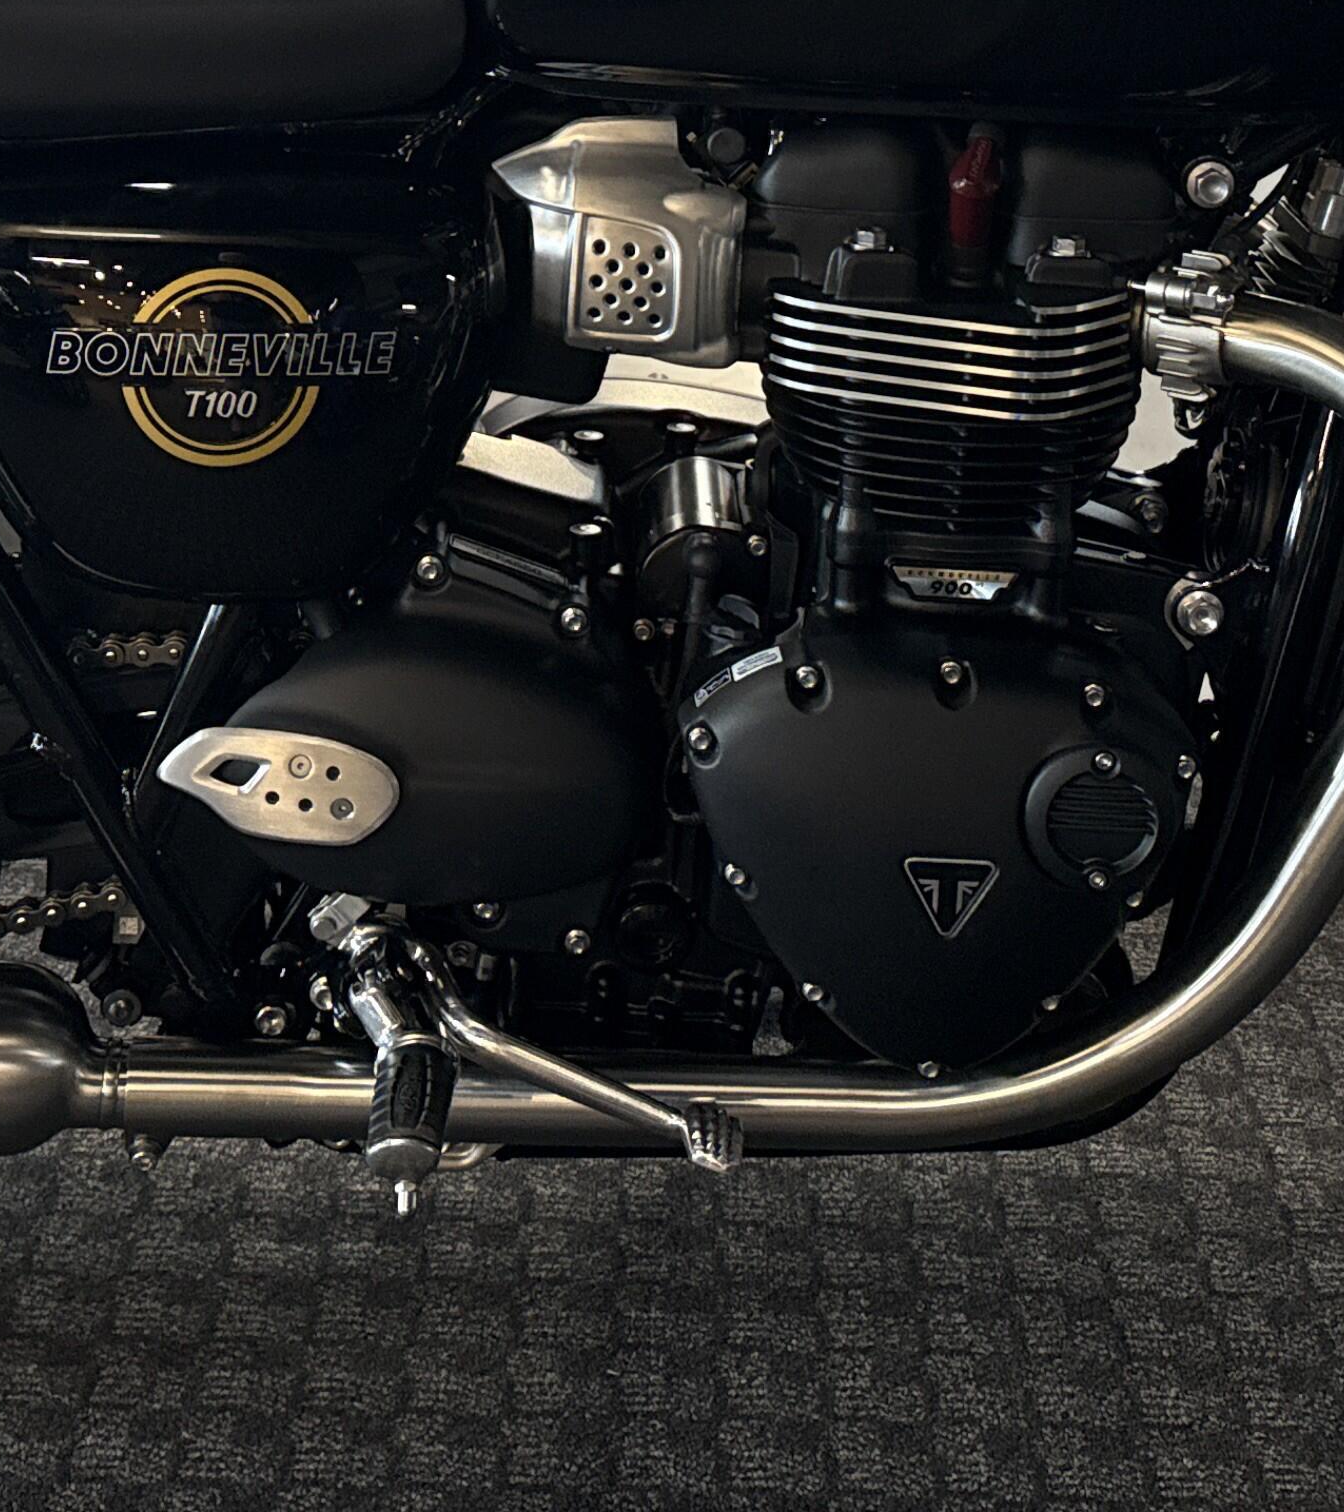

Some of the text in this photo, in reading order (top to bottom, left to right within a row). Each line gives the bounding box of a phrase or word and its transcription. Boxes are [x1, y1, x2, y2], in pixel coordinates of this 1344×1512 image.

[45, 330, 398, 377] BONNEVILLE
[184, 389, 258, 419] T100
[930, 579, 973, 596] 900
